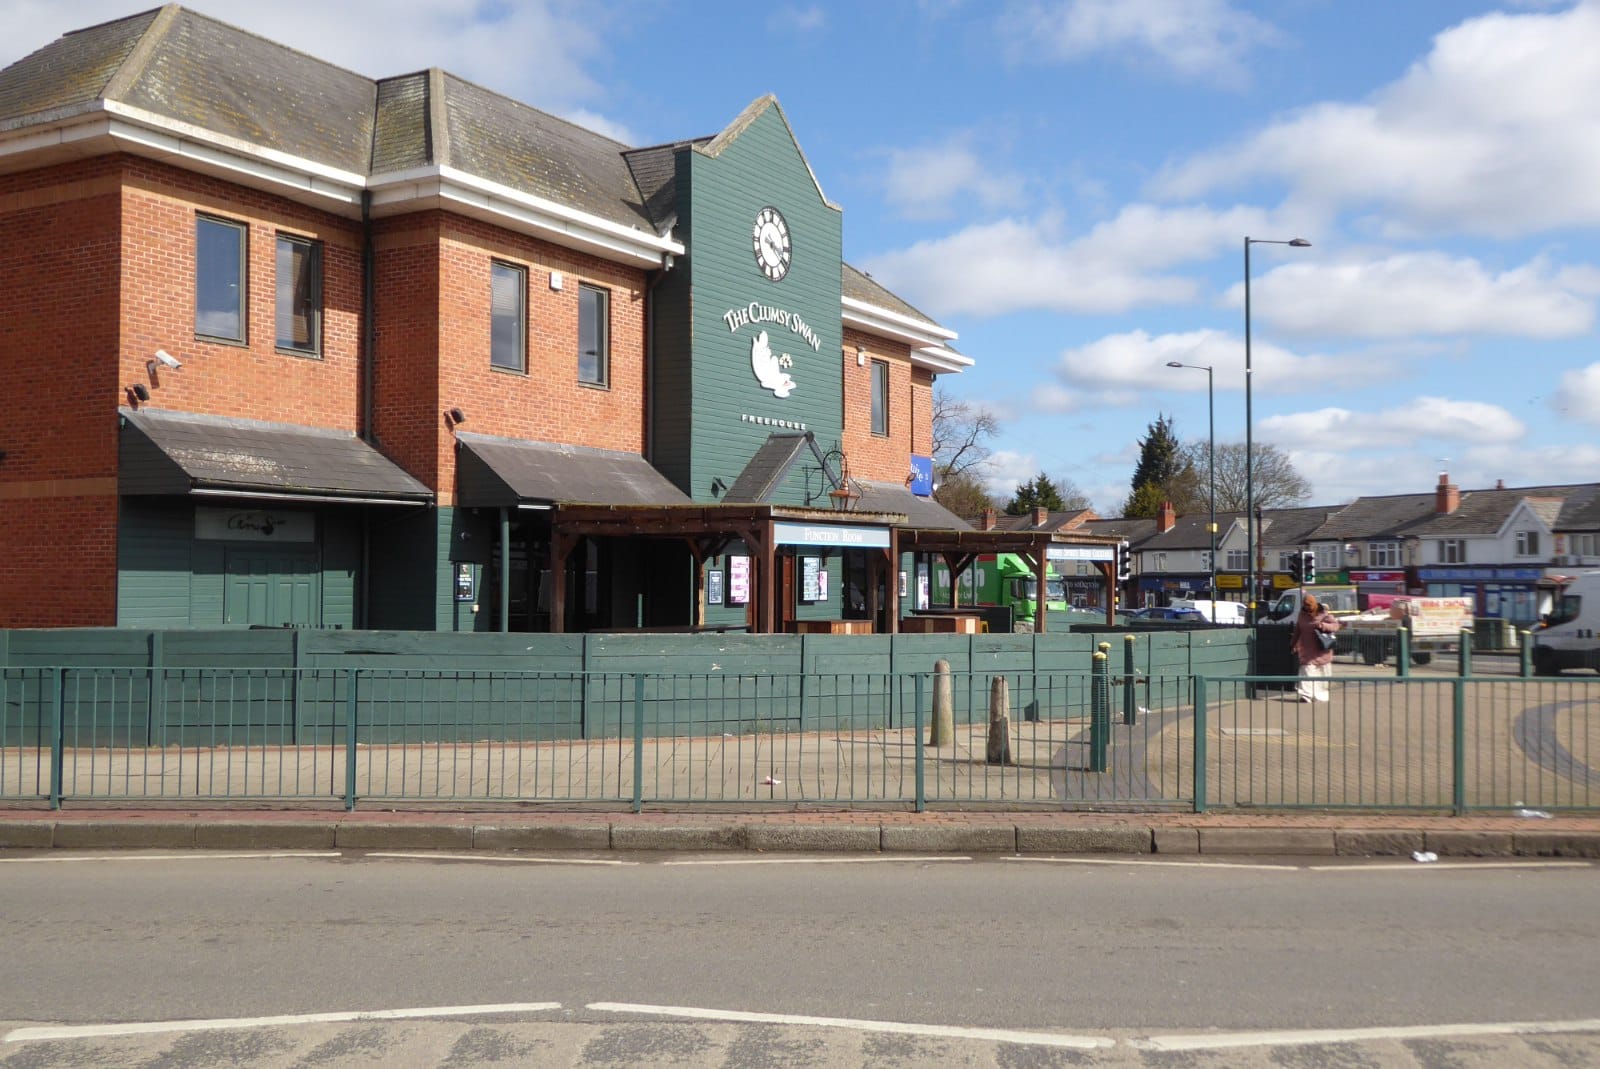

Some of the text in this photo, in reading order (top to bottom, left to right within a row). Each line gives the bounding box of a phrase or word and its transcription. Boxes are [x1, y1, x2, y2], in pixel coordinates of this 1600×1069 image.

[723, 302, 821, 352] THE CLUMSY SWAN
[741, 413, 807, 431] FREEHOUSE
[937, 568, 985, 588] wen
